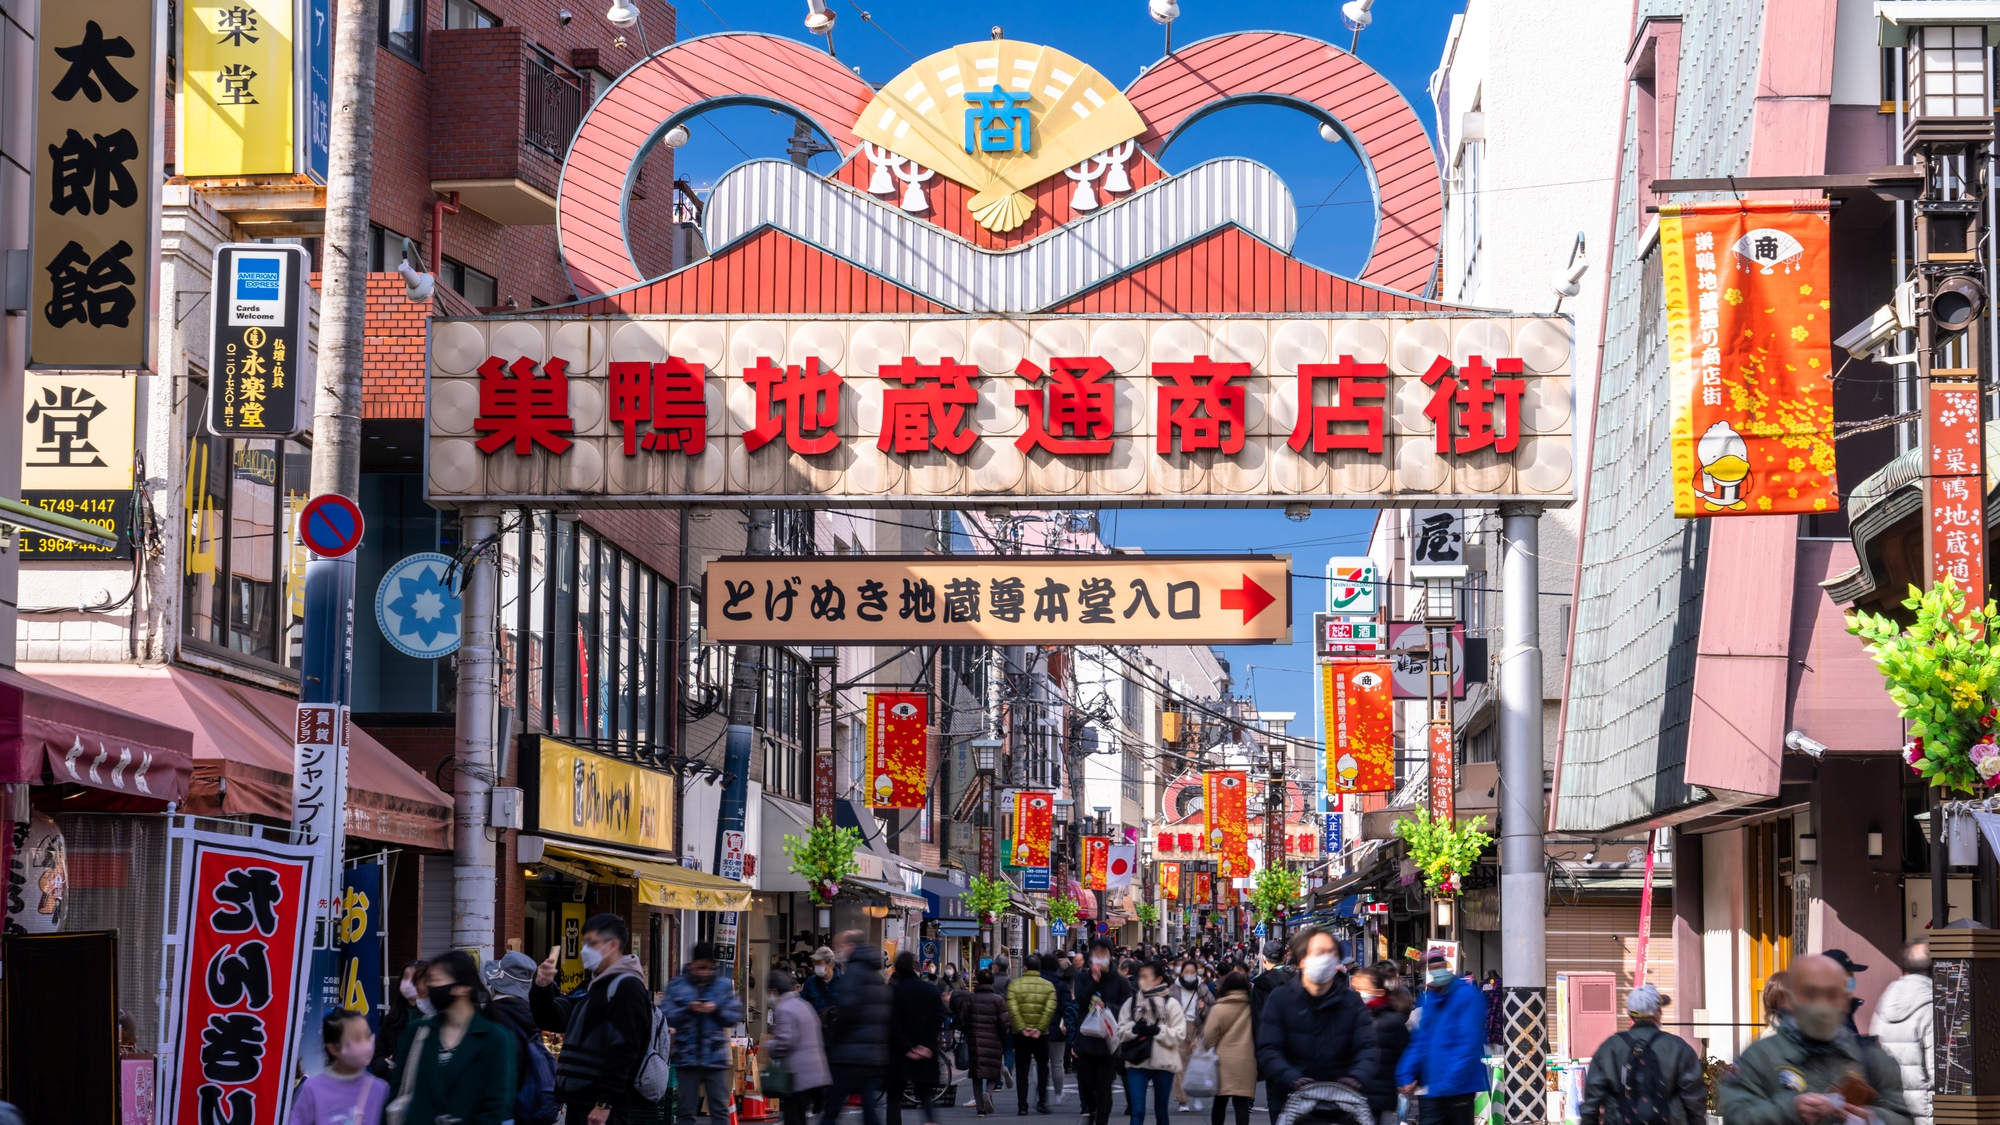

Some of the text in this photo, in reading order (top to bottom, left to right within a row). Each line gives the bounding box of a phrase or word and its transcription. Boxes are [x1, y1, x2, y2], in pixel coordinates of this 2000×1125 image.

[216, 5, 260, 106] 楽堂
[963, 83, 1032, 154] 商
[45, 19, 140, 330] 太郎飴
[237, 272, 278, 280] AMERICAN
[1754, 235, 1780, 262] 商
[1694, 231, 1722, 407] 巣鴨地蔵通り商店街
[239, 348, 267, 428] 永楽堂
[272, 338, 286, 389] 仏壇・仏具
[26, 385, 109, 468] 堂
[473, 354, 1525, 456] 巣鴨地蔵通商店街
[1416, 512, 1461, 562] 屋
[722, 575, 1202, 624] とげぬき地蔵尊本堂入口
[1331, 625, 1350, 638] たばこ
[1358, 625, 1371, 638] 酒
[1336, 673, 1347, 748] 巣鴨地蔵通り商店街
[1361, 675, 1373, 686] 商
[299, 709, 312, 743] マンション
[297, 747, 324, 846] シャンブル
